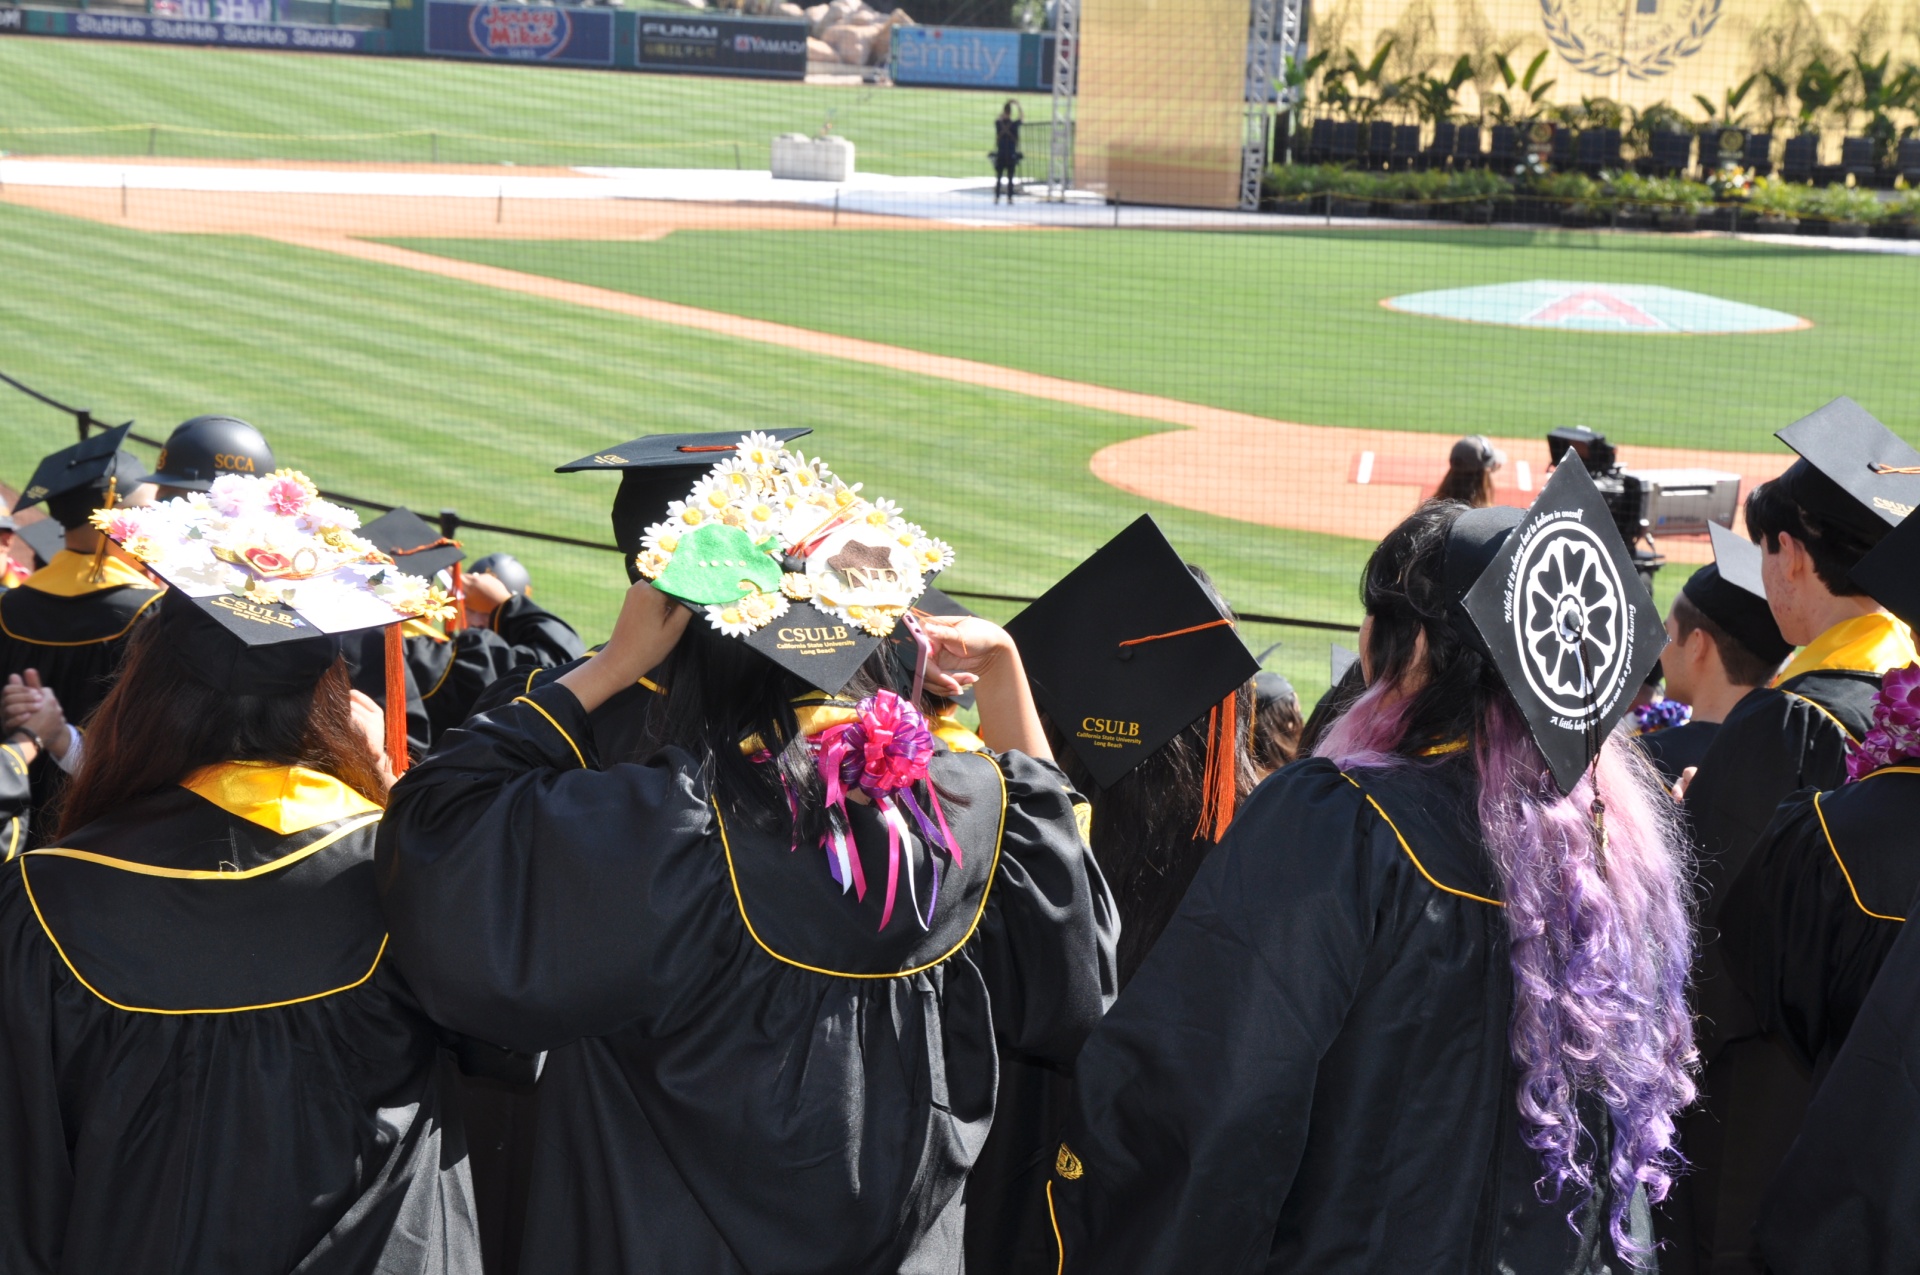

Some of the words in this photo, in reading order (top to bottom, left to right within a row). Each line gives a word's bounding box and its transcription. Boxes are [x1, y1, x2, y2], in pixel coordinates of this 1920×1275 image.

[485, 5, 555, 29] Jersey
[642, 22, 719, 37] FUNAI
[214, 453, 255, 472] SCCA
[217, 595, 294, 623] CSULB
[778, 626, 848, 642] CSULB
[1550, 716, 1558, 725] A
[1558, 718, 1574, 730] little
[1574, 719, 1586, 734] help
[1628, 604, 1636, 643] blessing
[1082, 717, 1140, 737] CSULB
[1076, 731, 1102, 740] California
[1102, 734, 1115, 742] State
[1115, 736, 1142, 745] University
[1093, 740, 1107, 748] Long
[1107, 741, 1123, 749] Beach
